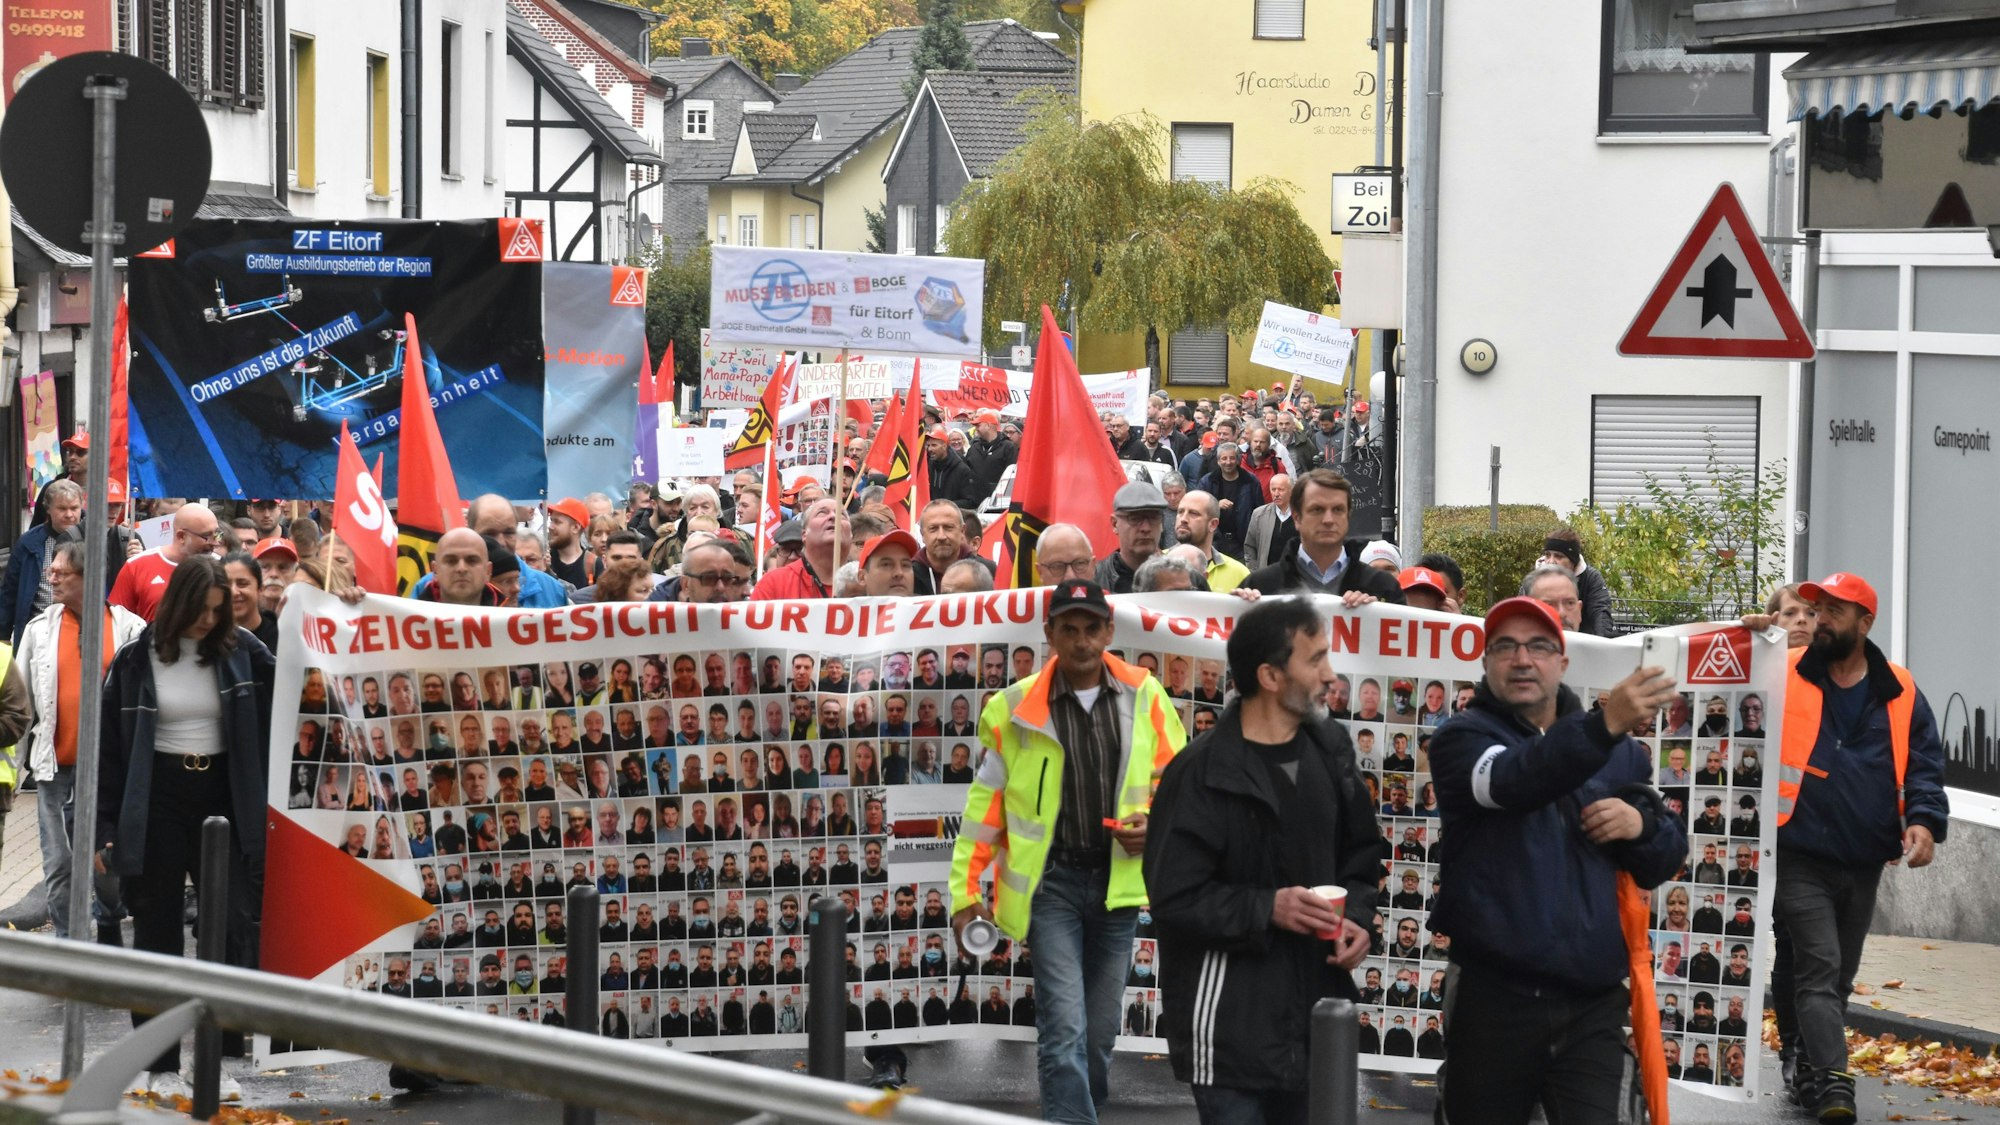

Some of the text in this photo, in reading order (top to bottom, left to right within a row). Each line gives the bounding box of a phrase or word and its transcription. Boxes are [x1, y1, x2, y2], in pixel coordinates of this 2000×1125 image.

[8, 23, 86, 38] 9499418
[1235, 71, 1331, 96] Haarstudio
[1289, 99, 1352, 124] Damen
[1360, 104, 1372, 121] &
[1353, 181, 1384, 197] Bei
[1347, 206, 1388, 227] Zoi
[293, 230, 383, 252] ZF Eitorf
[246, 253, 432, 277] Größter Ausbildungsbetrieb der Region
[725, 286, 771, 303] MUSS
[775, 281, 837, 300] BLEIBEN
[872, 275, 907, 288] BOGE
[849, 304, 914, 320] für Eitorf
[784, 325, 807, 335] GmbH
[860, 326, 873, 339] &
[877, 326, 912, 341] Bonn
[1263, 319, 1351, 350] Wir wollen Zukunft
[190, 314, 359, 403] Ohne uns ist die Zukunft
[1260, 338, 1273, 350] für
[1294, 349, 1312, 360] und
[1473, 351, 1487, 362] 10
[702, 384, 739, 402] Arbeit
[593, 435, 616, 447] am
[1829, 419, 1876, 447] Spielhalle
[1934, 425, 1991, 456] Gamepoint
[346, 613, 493, 655] ZEIGEN
[506, 602, 700, 646] GESICHT
[825, 601, 897, 637] DIE
[894, 841, 914, 850] nicht
